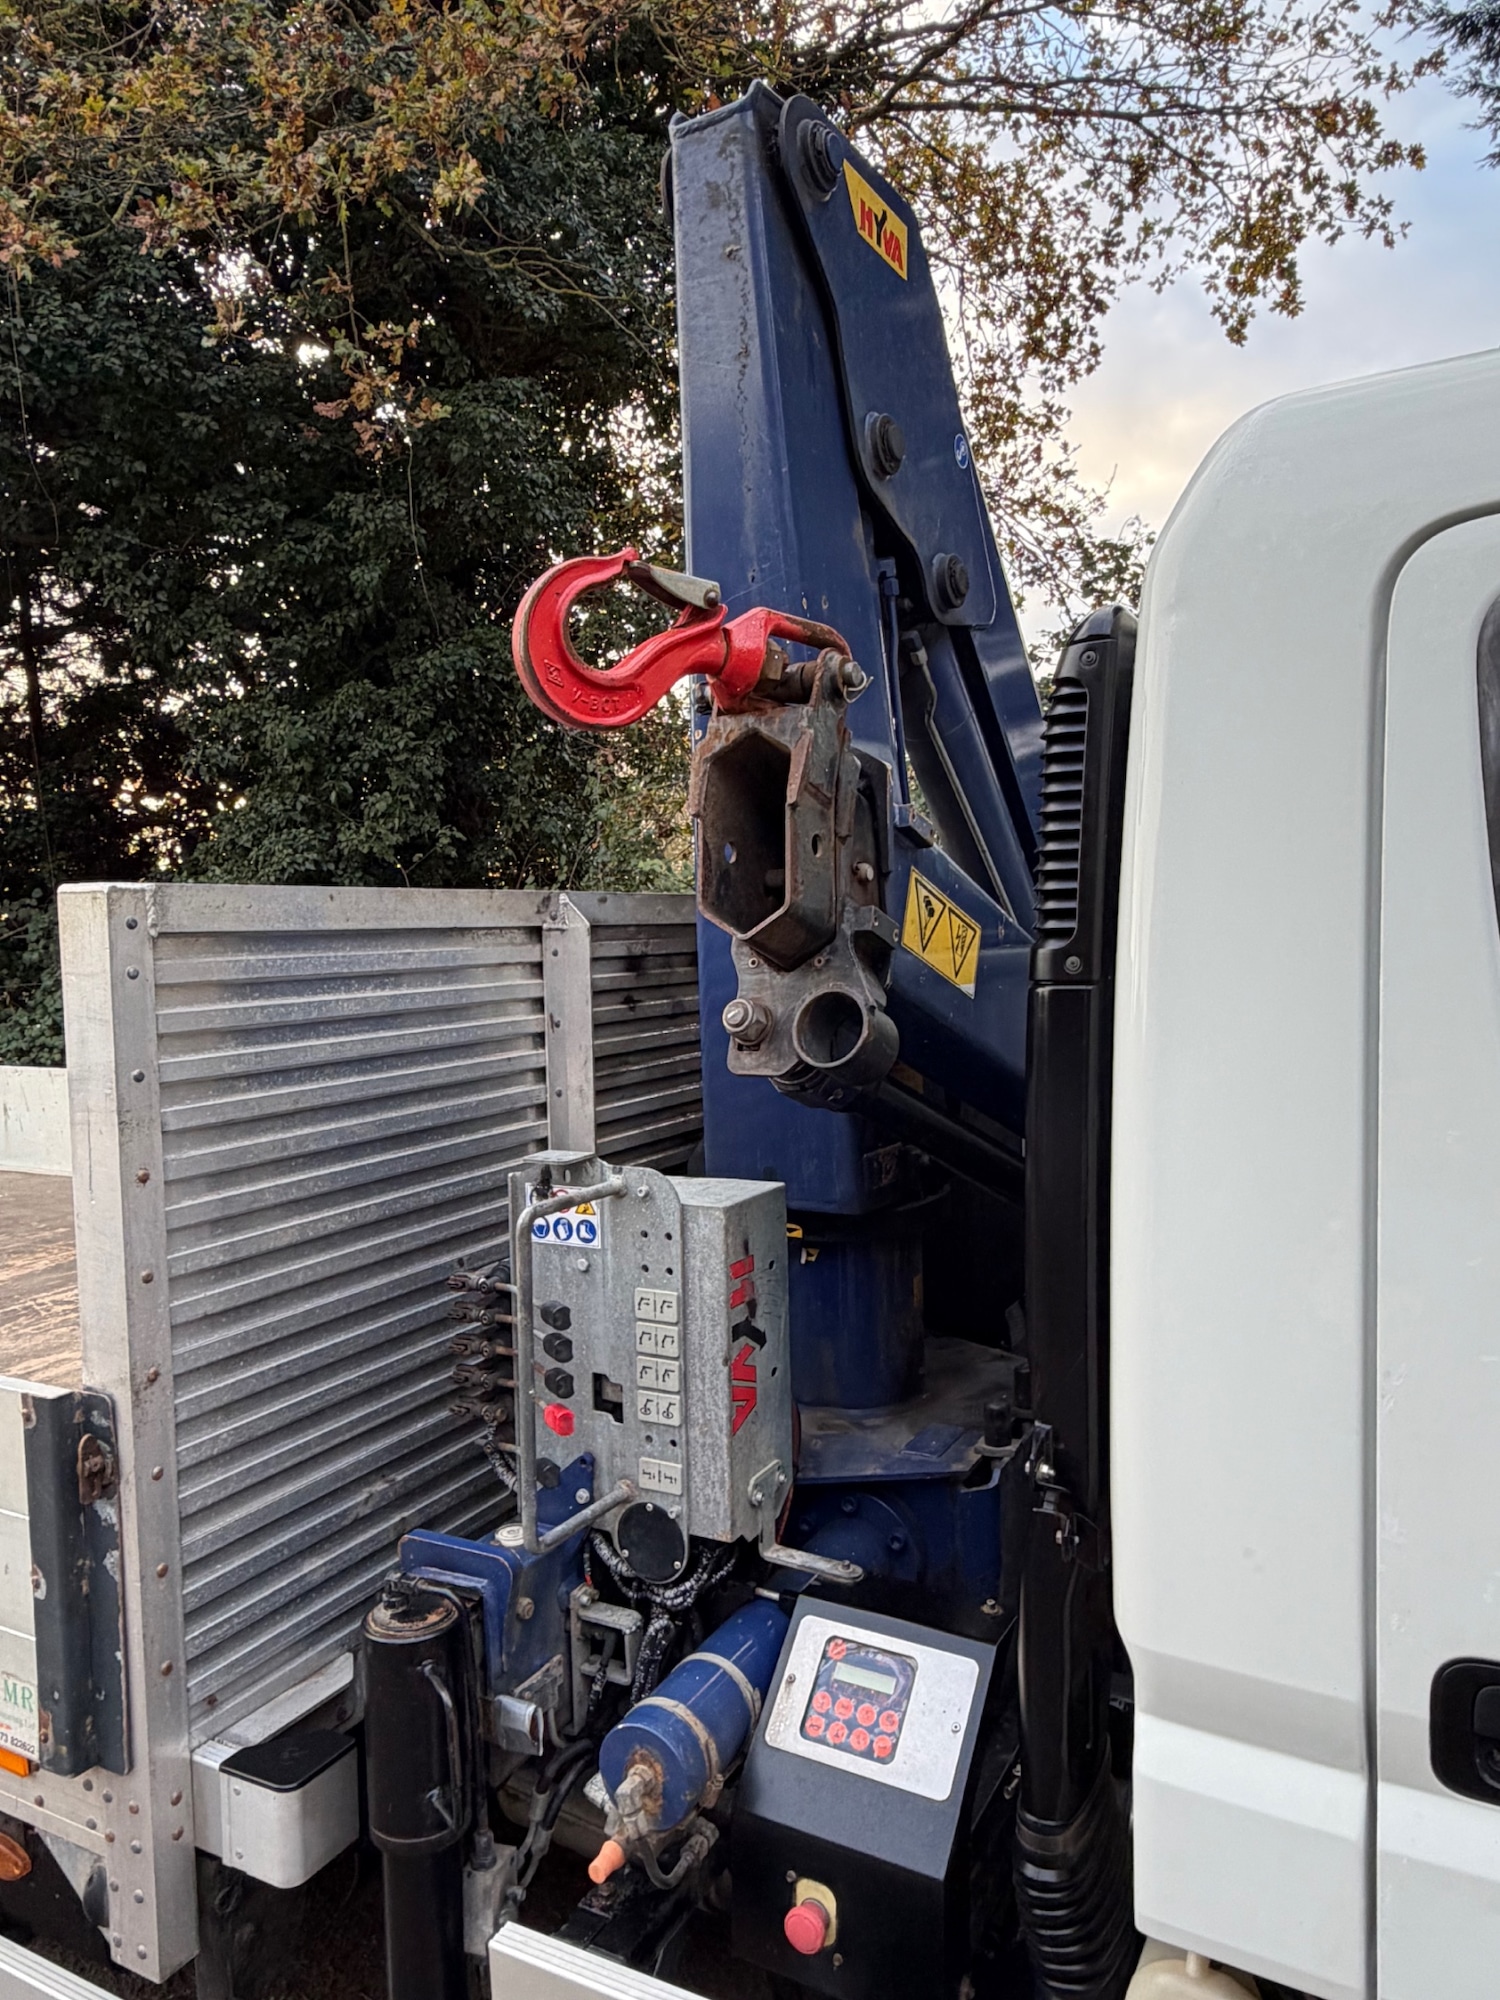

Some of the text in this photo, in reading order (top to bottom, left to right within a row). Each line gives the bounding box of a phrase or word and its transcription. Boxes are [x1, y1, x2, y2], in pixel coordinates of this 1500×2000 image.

[859, 198, 904, 272] HYVA
[729, 1254, 768, 1437] HYVA
[4, 1680, 33, 1713] MR
